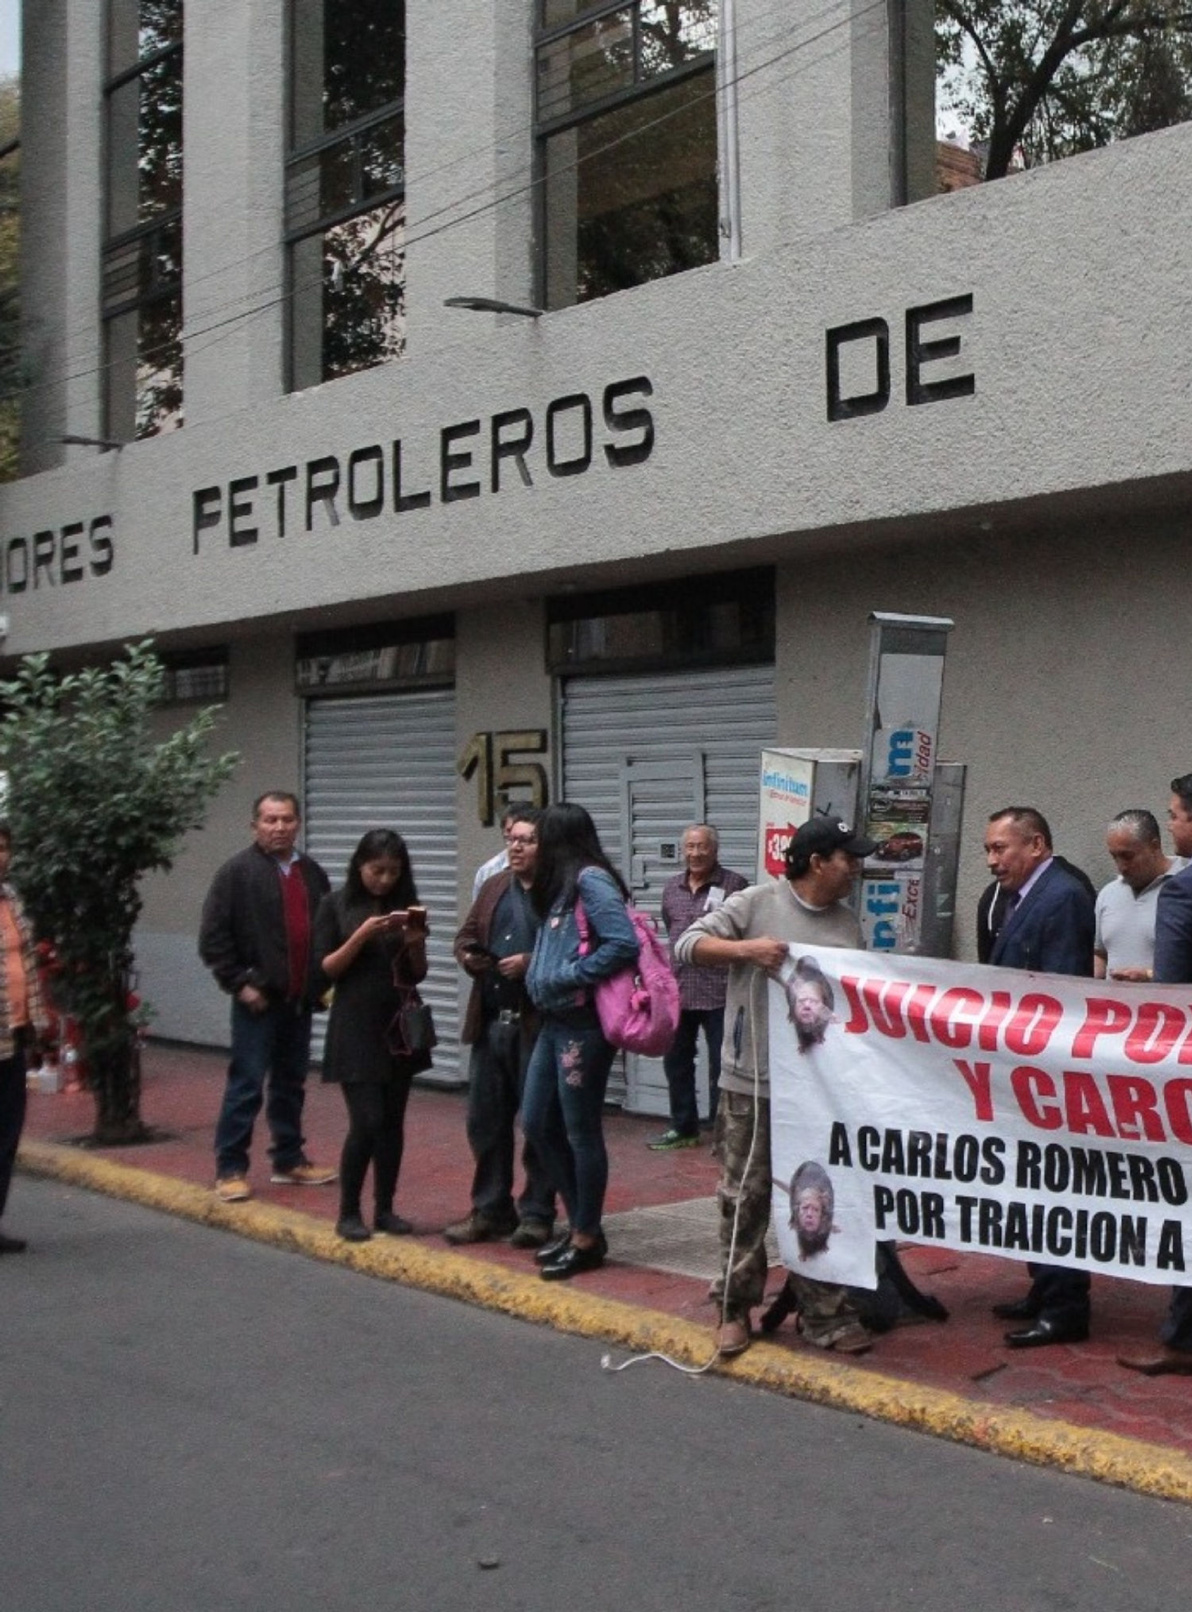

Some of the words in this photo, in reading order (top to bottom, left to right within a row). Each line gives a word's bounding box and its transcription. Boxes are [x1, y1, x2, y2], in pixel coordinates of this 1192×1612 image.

[0, 514, 114, 594] ORES
[192, 375, 655, 556] PETROLEROS
[826, 292, 976, 422] DE
[458, 729, 549, 829] 15
[840, 975, 1064, 1057] JUICIO
[954, 1059, 995, 1122] Y
[829, 1121, 853, 1167] A
[858, 1126, 1006, 1188] CARLOS
[1017, 1140, 1188, 1206] ROMERO
[873, 1185, 945, 1240] POR
[955, 1195, 1148, 1267] TRAICION
[1157, 1219, 1186, 1272] A
